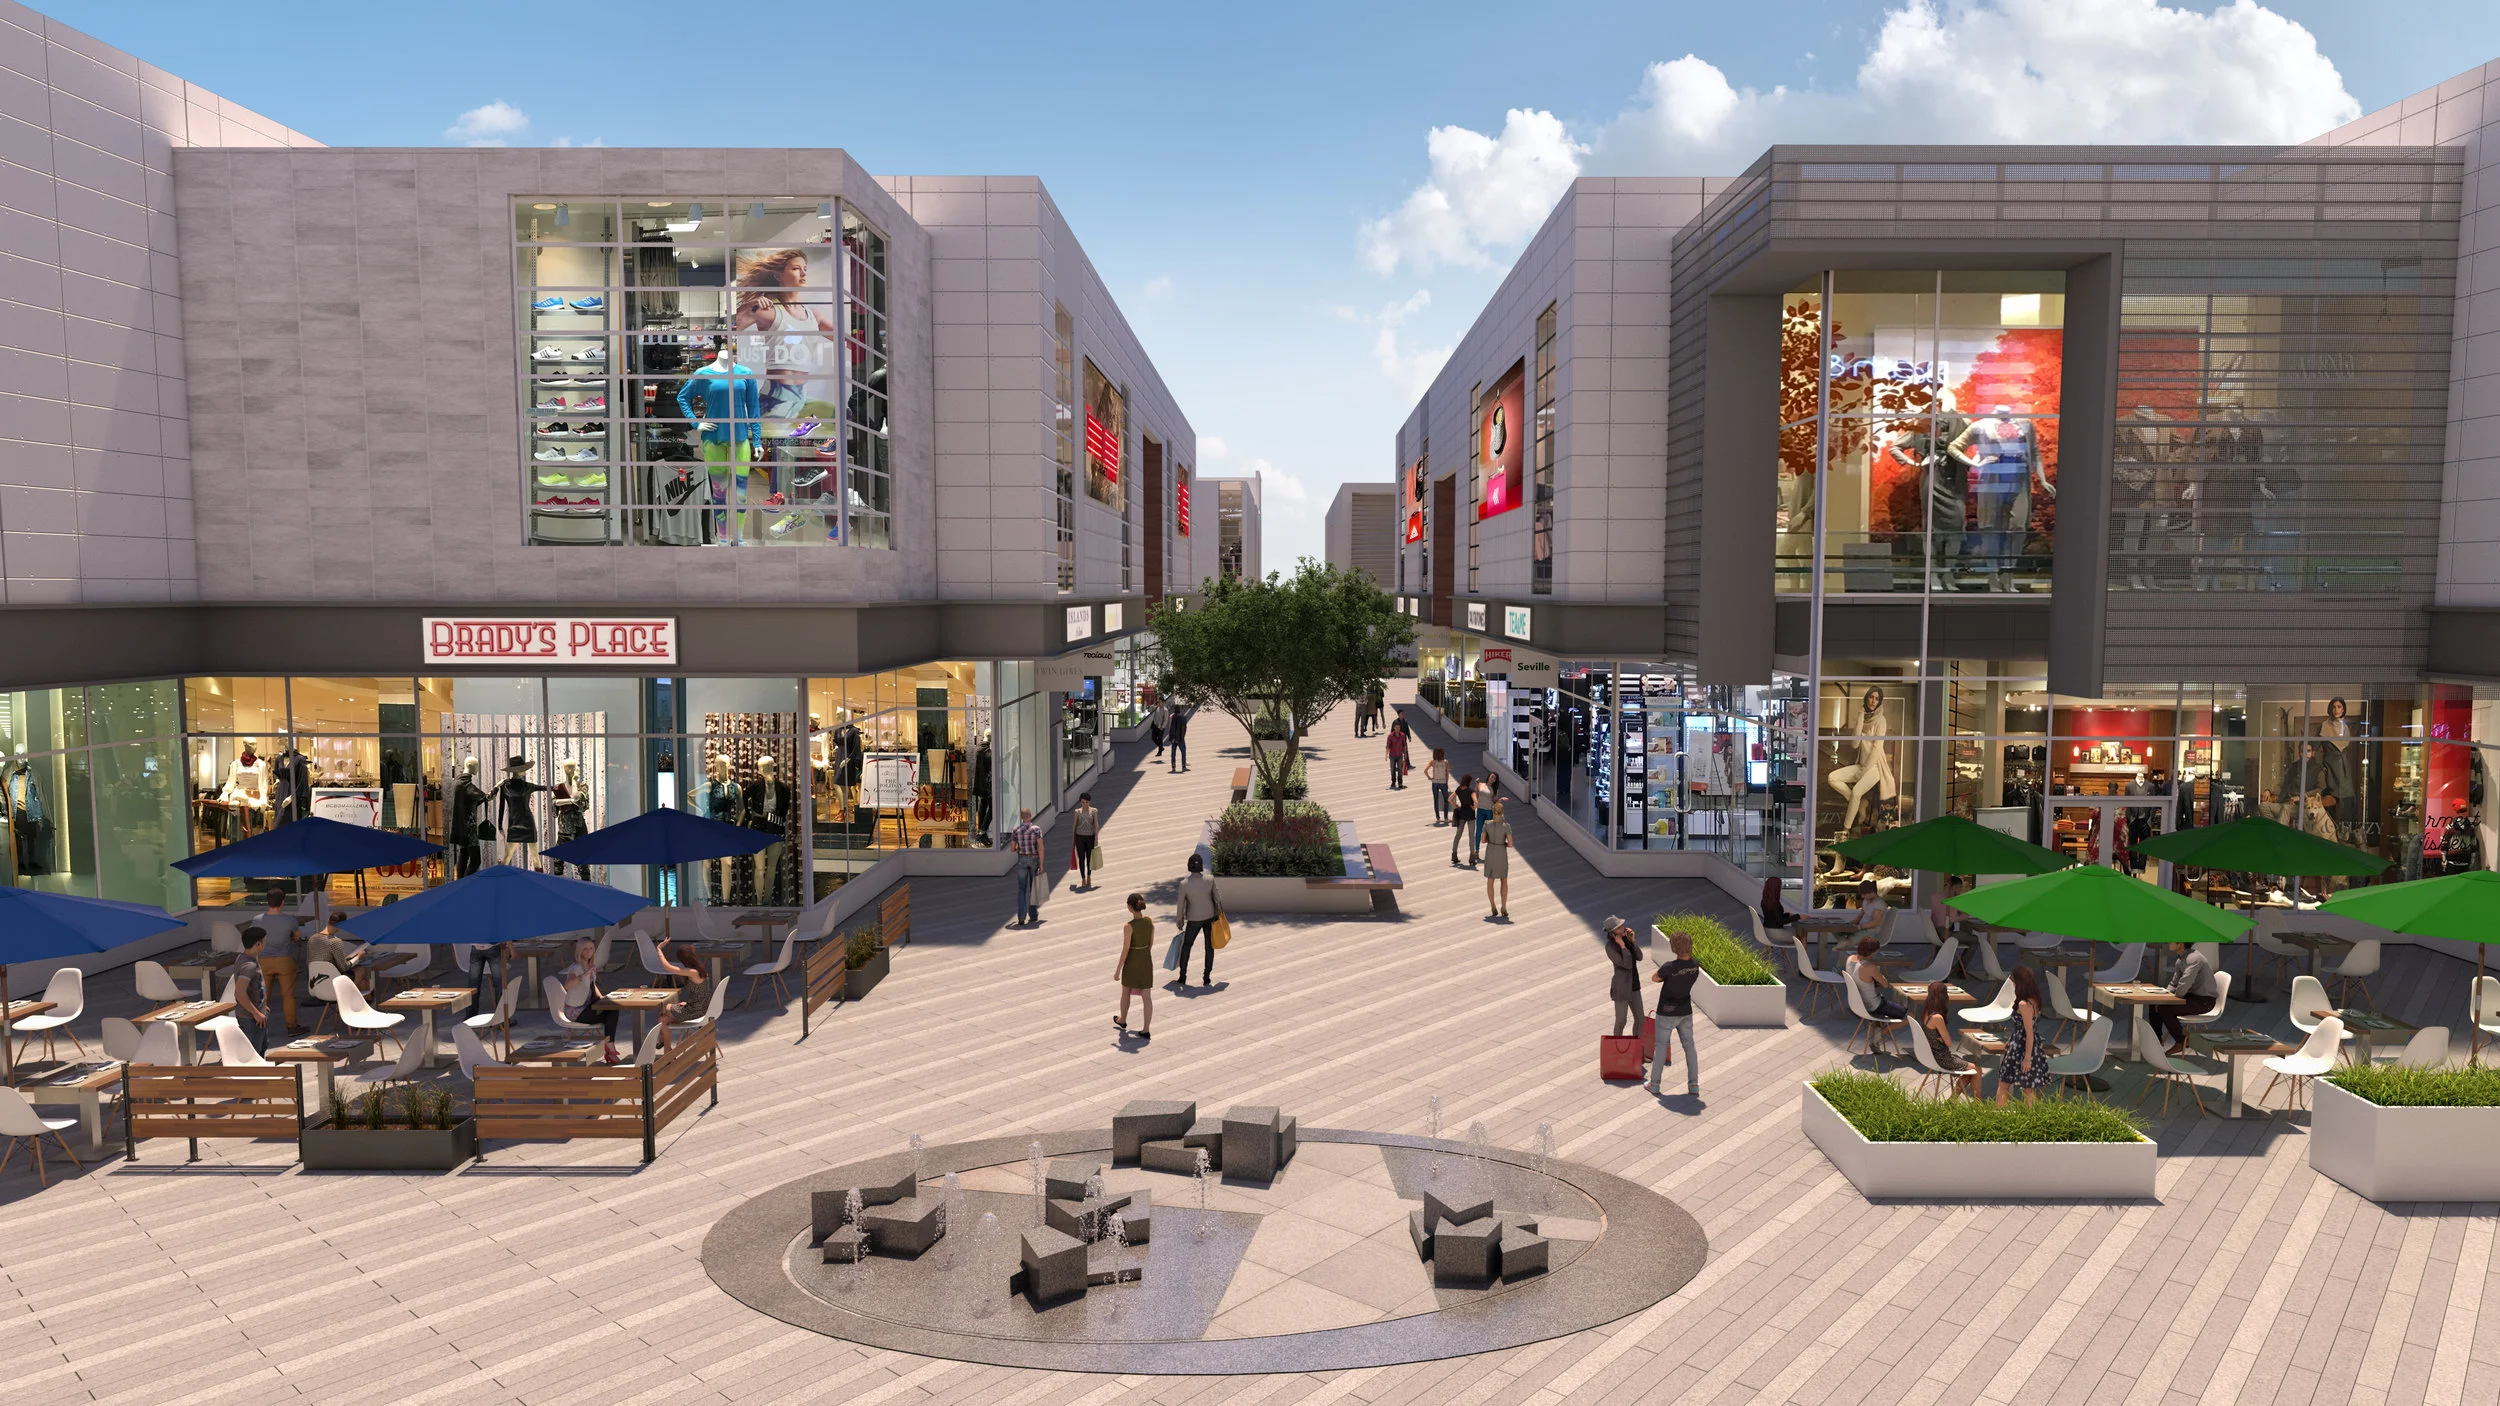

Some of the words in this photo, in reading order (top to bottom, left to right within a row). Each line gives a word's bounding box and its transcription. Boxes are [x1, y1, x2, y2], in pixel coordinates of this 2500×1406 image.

[774, 344, 811, 365] DO
[664, 471, 694, 500] NIKE
[1484, 651, 1512, 661] HIKER
[1517, 662, 1550, 671] Seville
